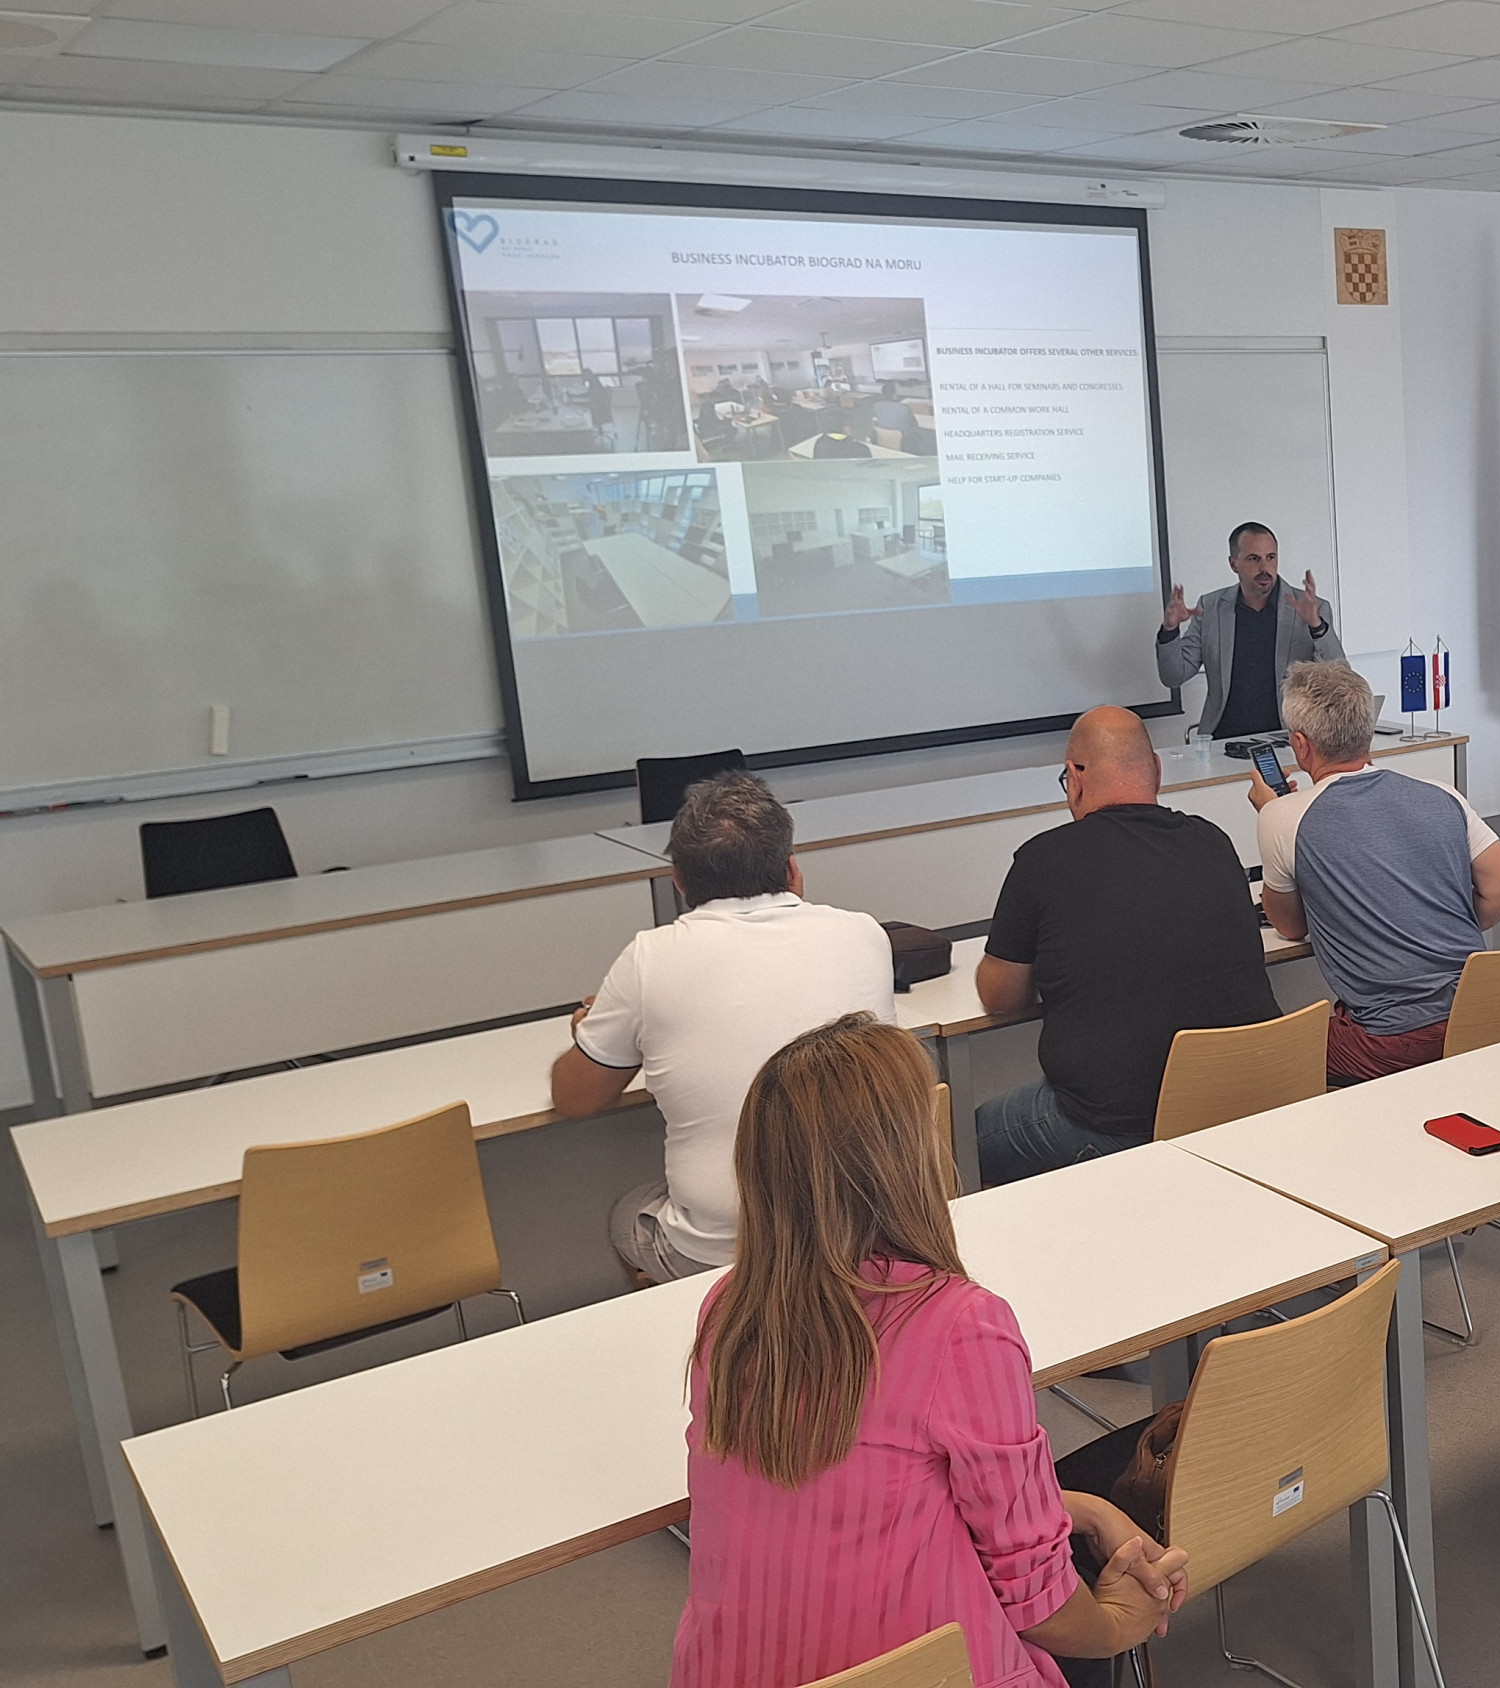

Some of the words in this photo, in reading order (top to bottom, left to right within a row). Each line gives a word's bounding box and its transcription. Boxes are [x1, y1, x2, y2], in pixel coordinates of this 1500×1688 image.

[671, 252, 732, 265] BUSINESS
[735, 254, 805, 267] INCUBATOR
[808, 256, 862, 269] BIOGRAD
[866, 258, 883, 269] NA
[885, 259, 922, 271] MORU
[936, 347, 973, 356] BUSINESS
[975, 348, 1018, 356] INCUBATOR
[1020, 348, 1047, 356] OFFERS
[939, 383, 968, 391] RENTAL
[969, 383, 979, 391] OF
[980, 383, 987, 391] A
[988, 383, 1006, 391] HALL
[1008, 383, 1022, 391] FOR
[1024, 383, 1061, 391] SEMINARS
[1062, 383, 1077, 391] AND
[1079, 383, 1123, 391] CONGRESSES
[941, 406, 969, 415] RENTAL
[971, 406, 981, 414] OF
[983, 406, 989, 414] A
[990, 406, 1027, 414] COMMON
[1028, 406, 1050, 414] WORK
[1052, 406, 1070, 414] HALL
[944, 429, 1003, 438] HEADQUARTERS
[1005, 428, 1055, 437] REGISTRATION
[1056, 428, 1084, 436] SERVICE
[946, 454, 965, 462] MAIL
[966, 453, 1005, 461] RECEIVING
[1007, 452, 1035, 460] SERVICE
[948, 476, 967, 485] HELP
[968, 476, 983, 484] FOR
[984, 475, 1019, 483] START-UP
[1020, 473, 1062, 482] COMPANIES
